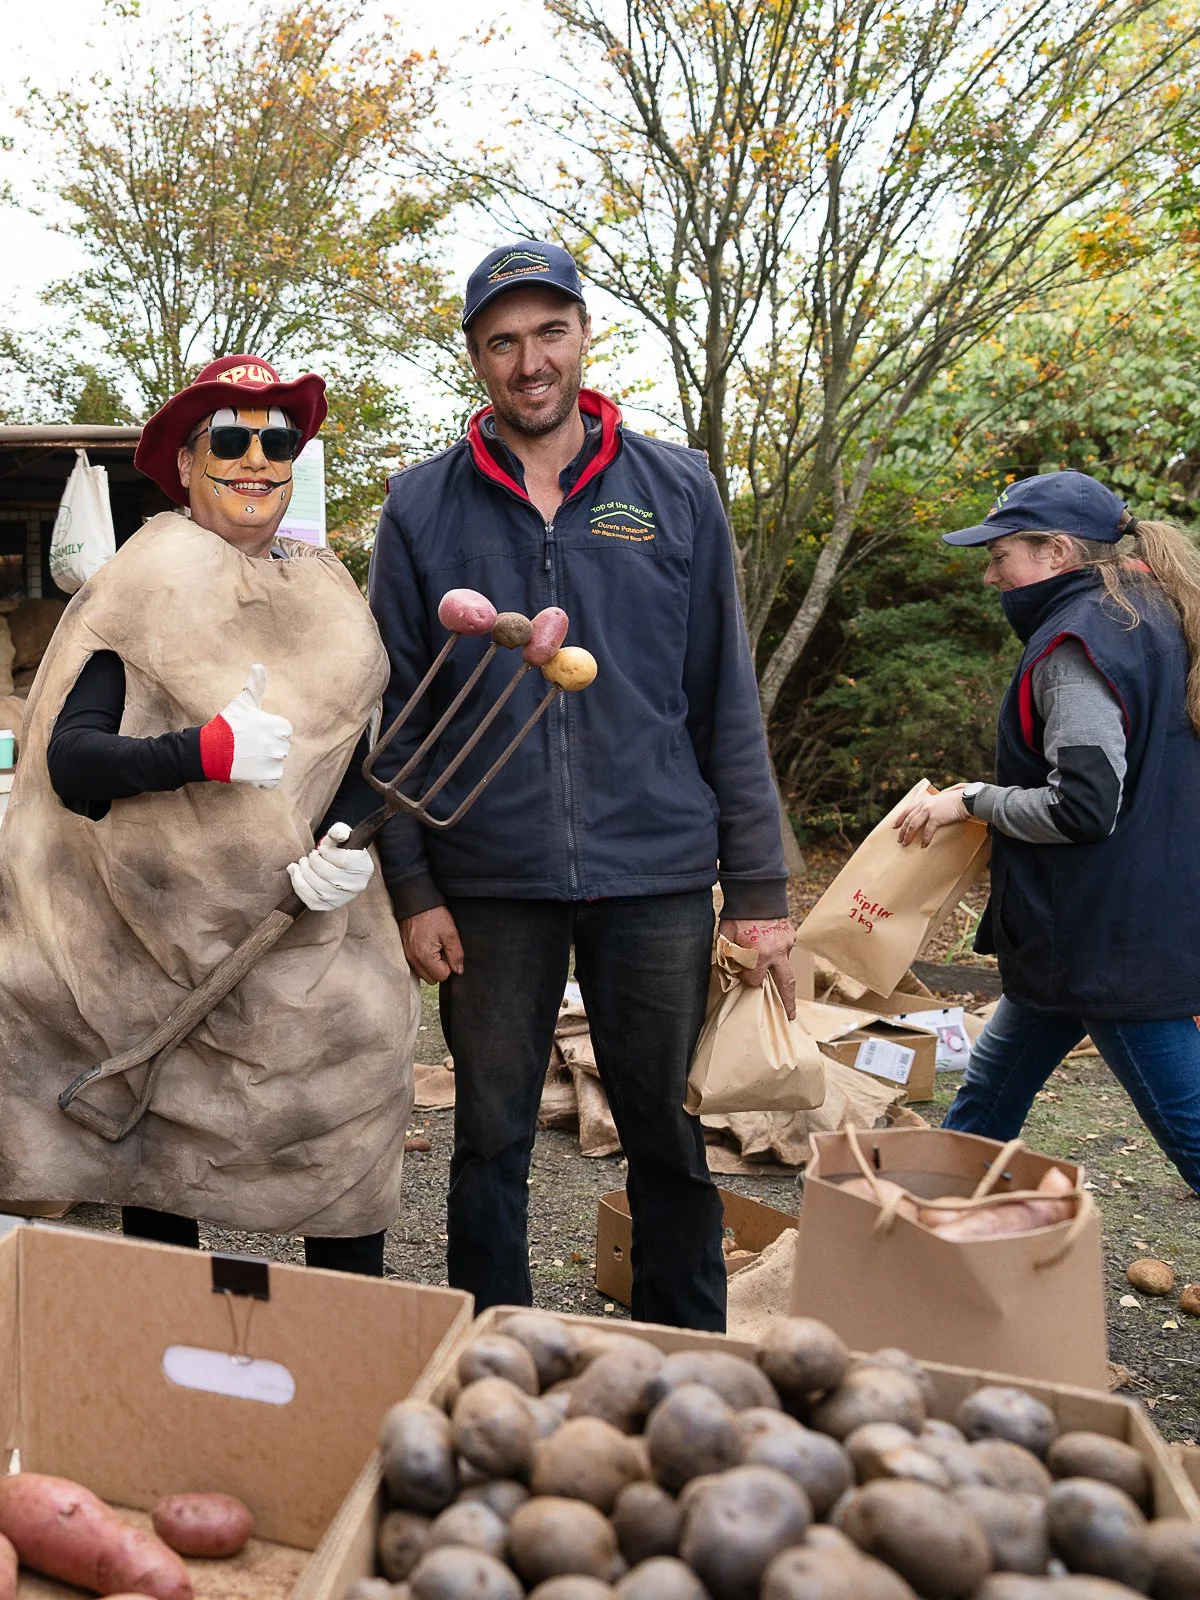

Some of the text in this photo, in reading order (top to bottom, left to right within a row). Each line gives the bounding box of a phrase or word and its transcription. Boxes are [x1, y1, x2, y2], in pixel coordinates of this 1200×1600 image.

[591, 504, 606, 513] Top
[629, 505, 654, 518] Range
[621, 525, 649, 534] Potatoes
[54, 543, 84, 558] AMILY
[857, 913, 873, 934] kg
